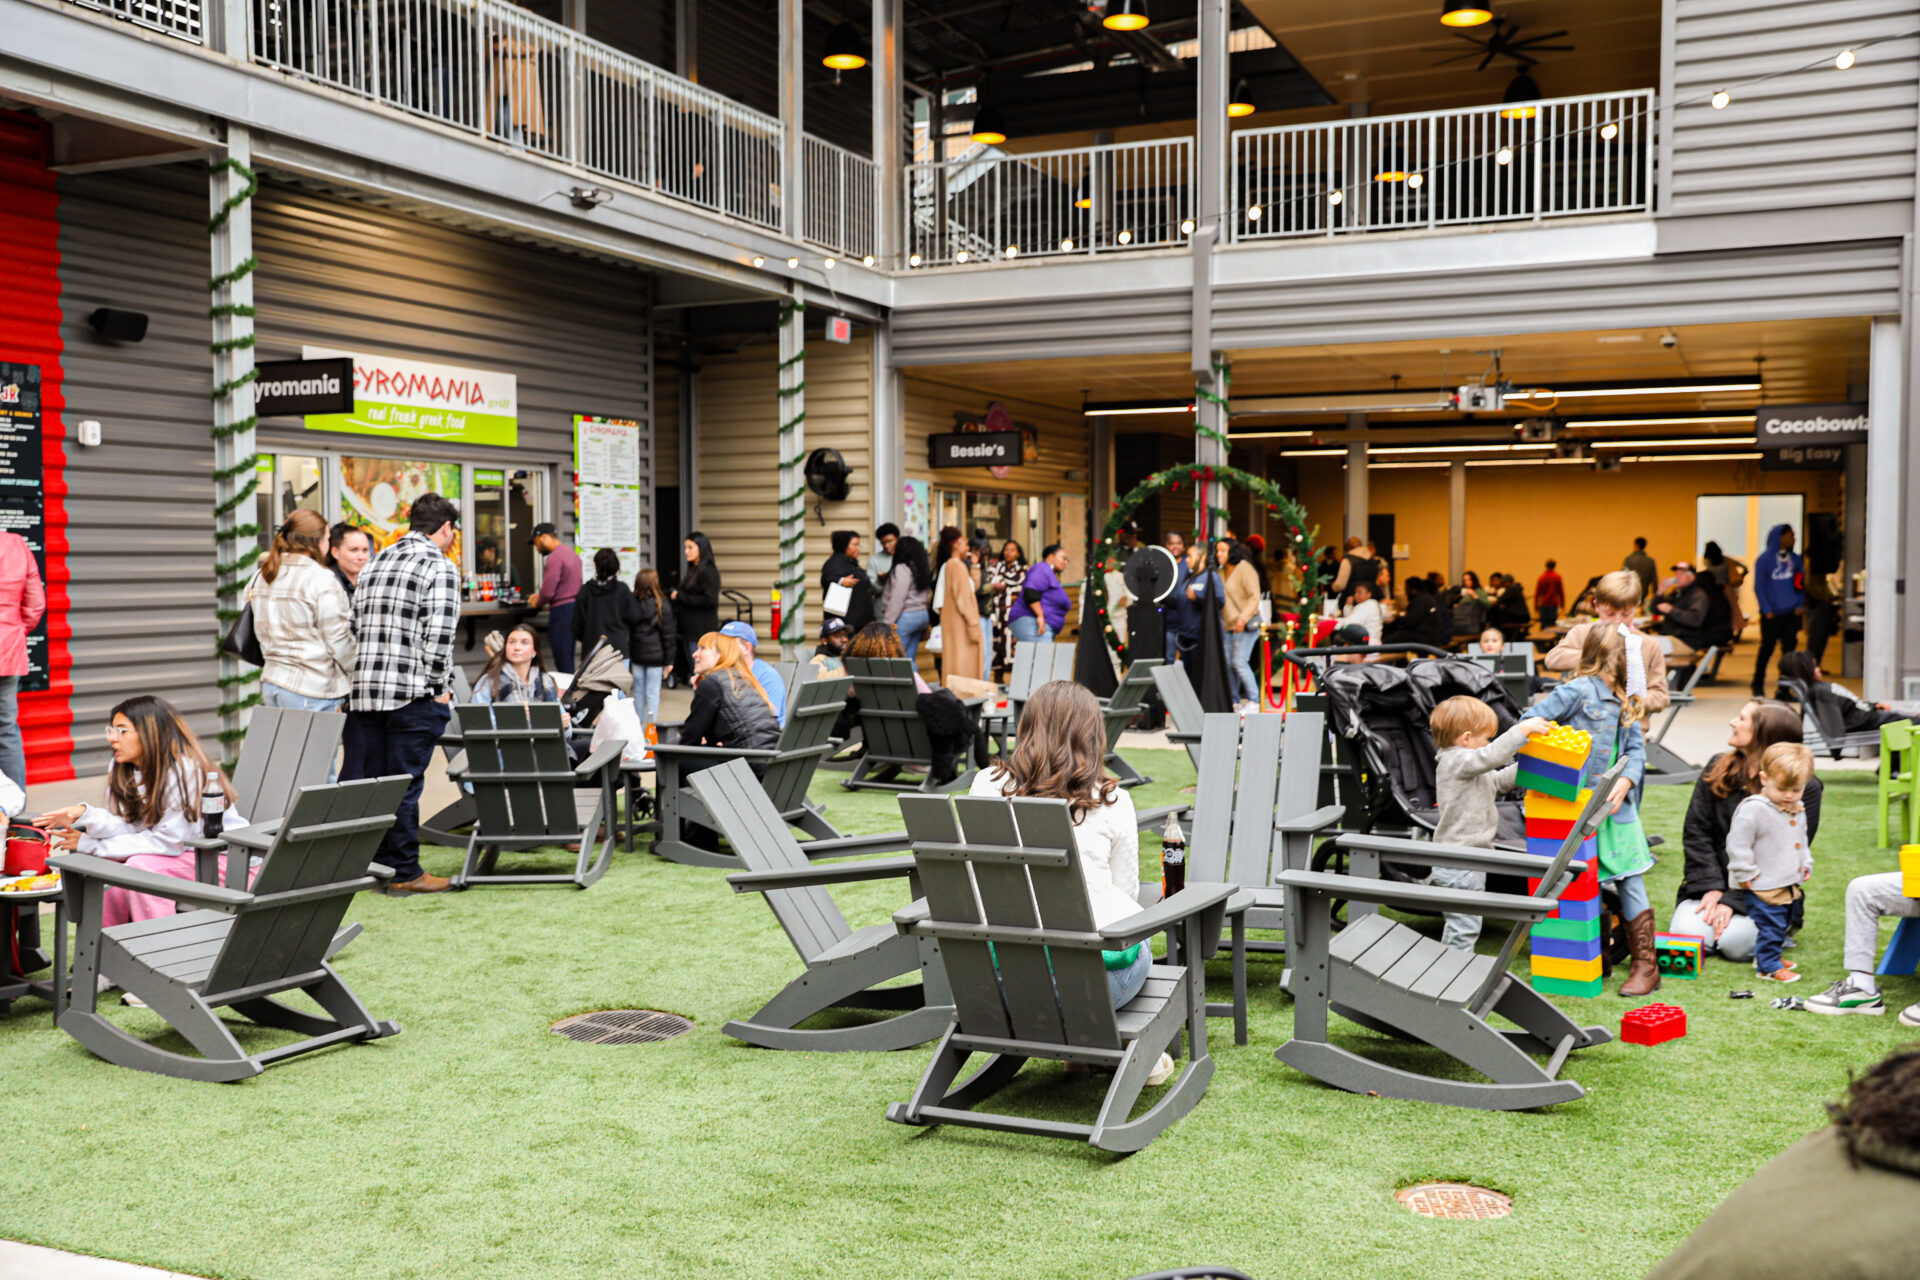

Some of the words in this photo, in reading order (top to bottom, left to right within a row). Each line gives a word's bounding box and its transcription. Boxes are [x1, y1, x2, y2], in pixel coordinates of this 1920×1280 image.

[254, 373, 340, 403] yromania
[368, 406, 388, 421] real
[389, 407, 417, 424] fresh
[418, 413, 444, 429] greek
[445, 413, 467, 430] food
[950, 443, 1005, 458] Bessie's
[1780, 447, 1803, 463] Big
[1805, 448, 1841, 462] Easy
